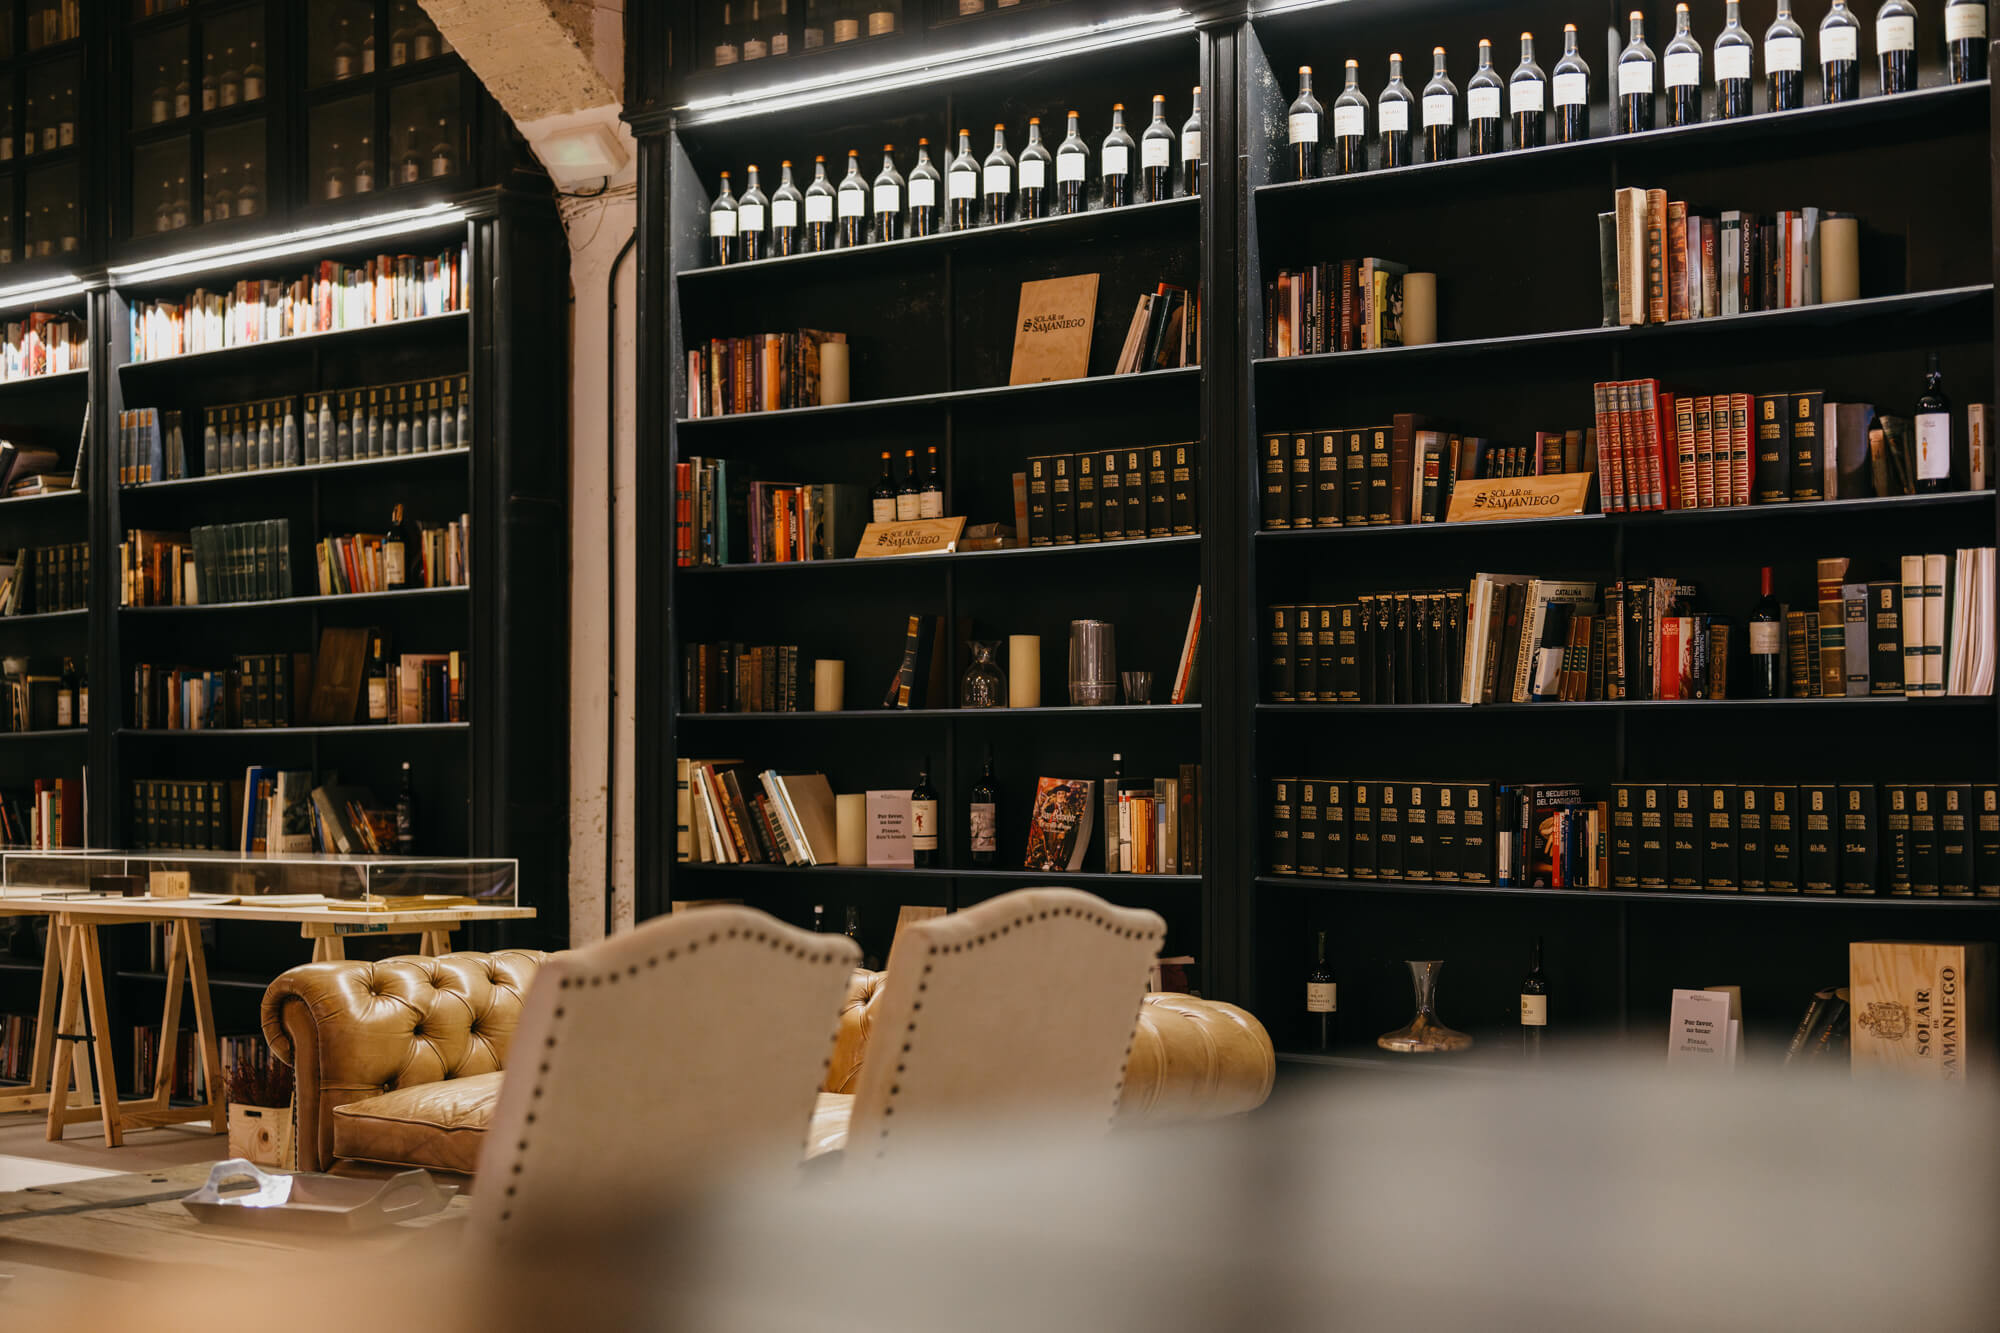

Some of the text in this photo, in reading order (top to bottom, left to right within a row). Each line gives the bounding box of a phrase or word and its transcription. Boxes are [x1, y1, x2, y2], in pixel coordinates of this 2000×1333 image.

[1034, 314, 1056, 322] SOLAR
[1032, 318, 1085, 333] SAMANIEGO
[1490, 489, 1521, 497] SOLAR
[1487, 495, 1560, 510] SAMANIEGO
[887, 535, 940, 548] SAMANIEGO
[1546, 789, 1580, 797] SECUESTRO
[1549, 797, 1581, 805] CANDIDATO
[1918, 991, 1930, 1056] SOLAR
[1943, 968, 1956, 1080] SAMANIEGO
